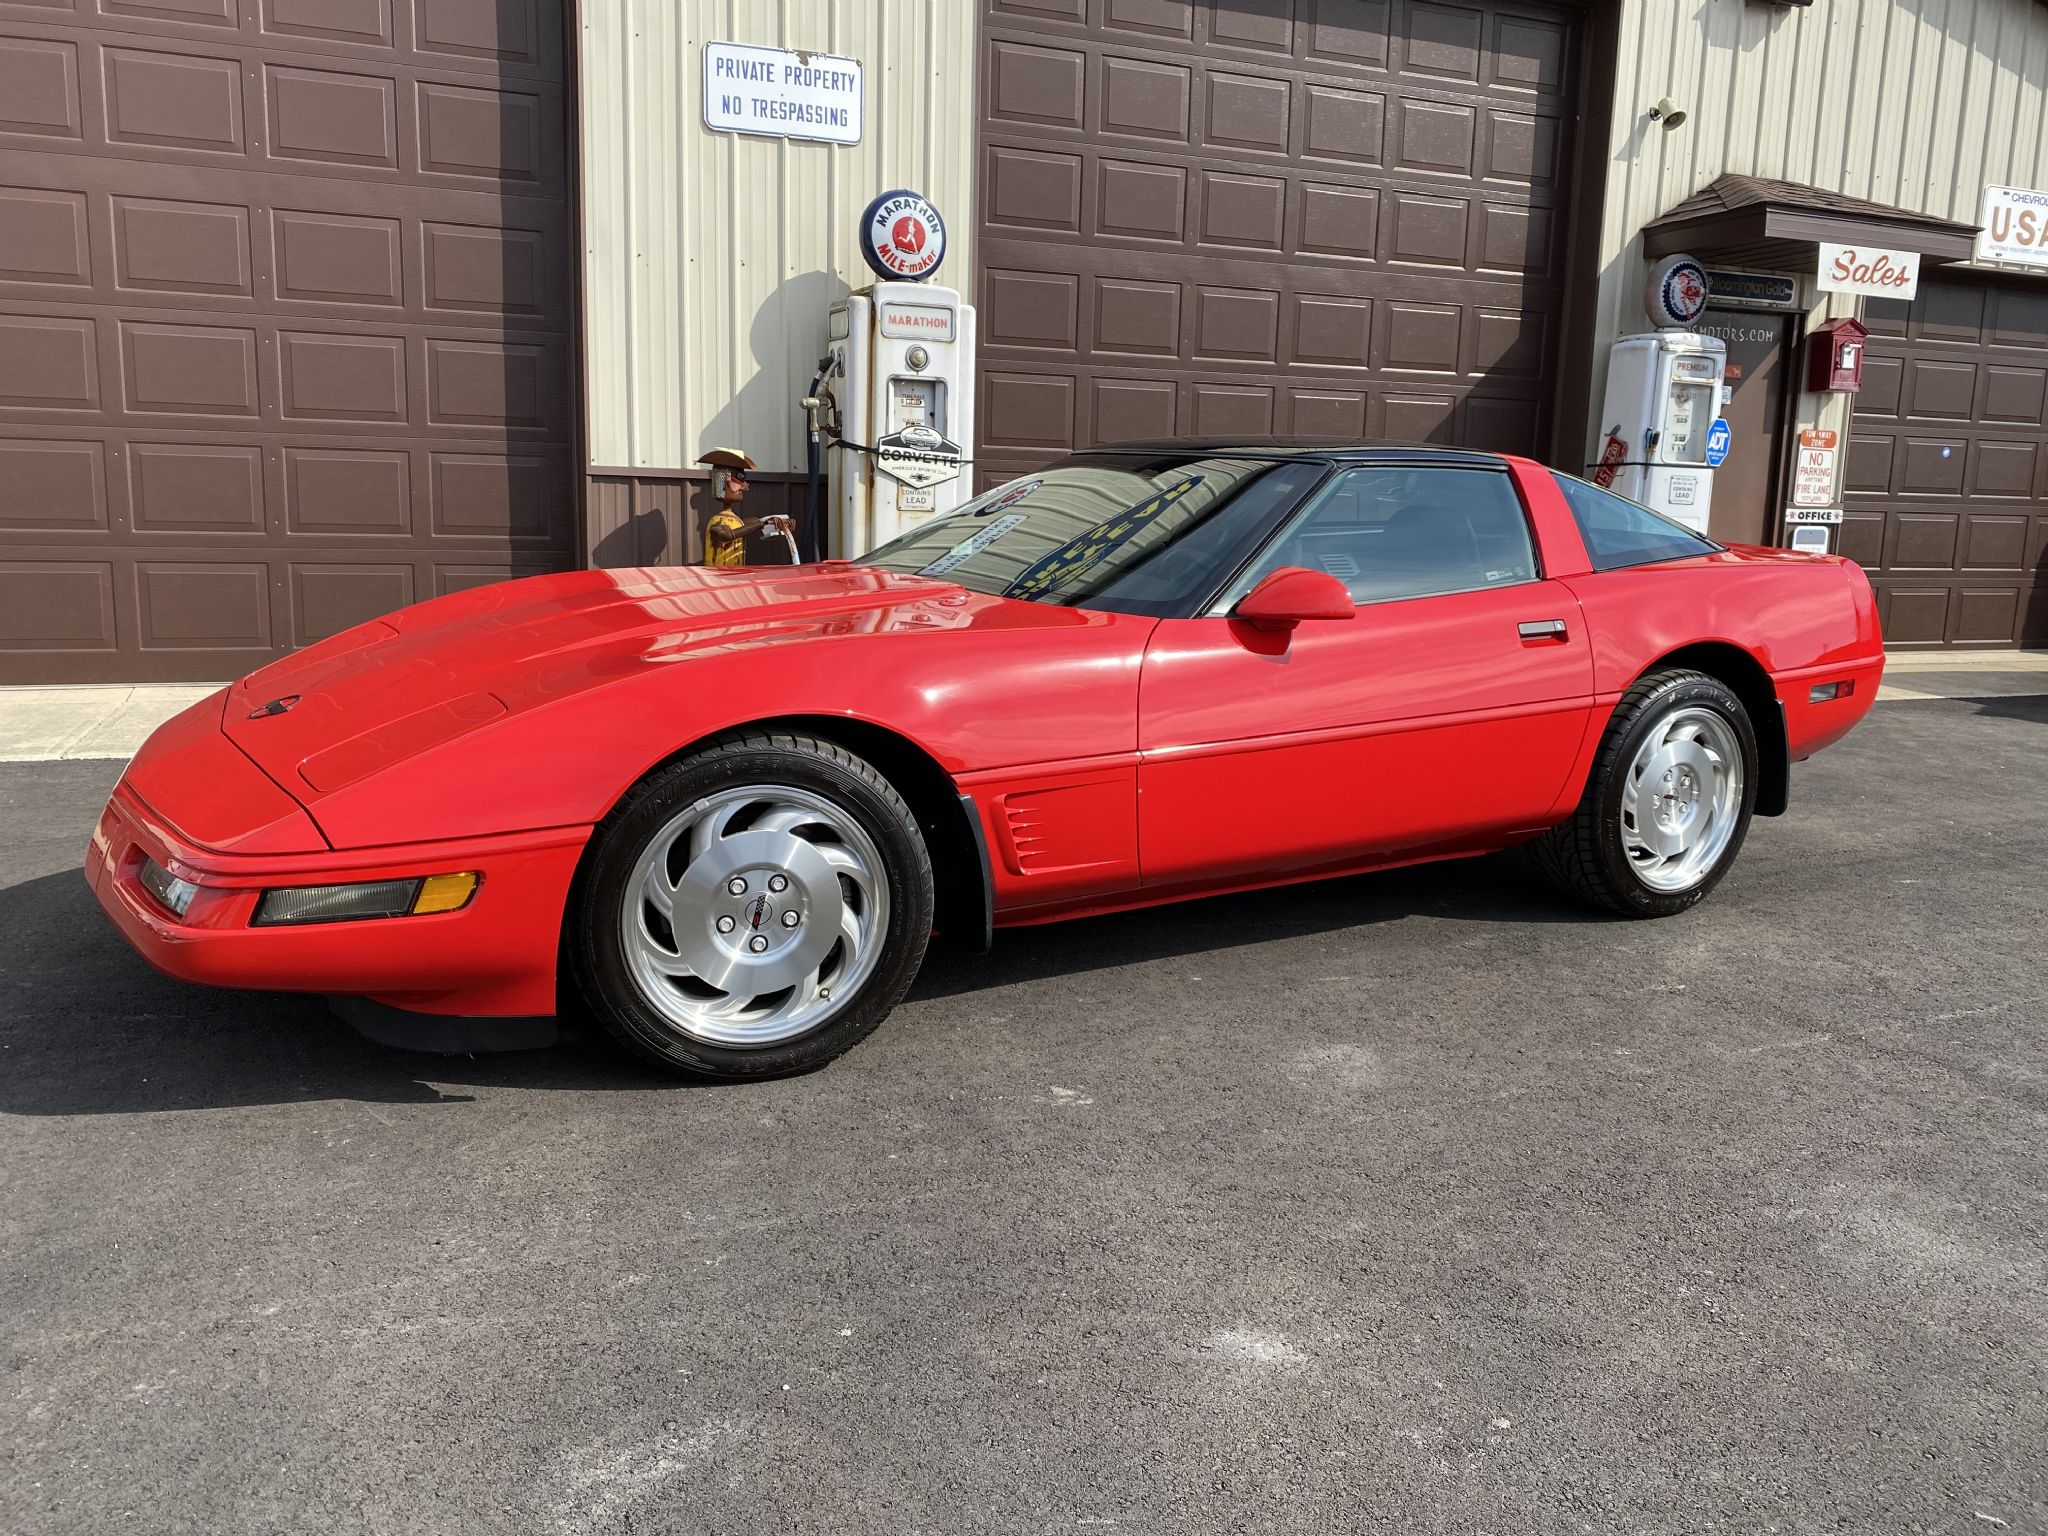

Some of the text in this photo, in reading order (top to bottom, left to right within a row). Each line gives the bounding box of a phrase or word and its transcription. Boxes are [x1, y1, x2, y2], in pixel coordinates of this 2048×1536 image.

[716, 57, 856, 92] PRIVATE PROPERTY
[722, 94, 848, 127] NO TRESPASSING
[876, 198, 940, 234] MARATHON
[877, 242, 937, 273] MILE-maker
[1832, 249, 1911, 287] Sales
[1765, 281, 1786, 296] Gold
[888, 314, 948, 329] MARATHON
[1677, 362, 1709, 373] PREMIUM
[1708, 431, 1729, 451] ADT
[1810, 439, 1826, 448] ZONE
[881, 448, 958, 469] CORVETTE
[1809, 452, 1824, 466] NO
[1800, 466, 1831, 478] PARKING
[901, 489, 932, 497] CONTAINS
[1797, 484, 1831, 495] FIRE LANE
[906, 497, 927, 505] LEAD
[1797, 511, 1832, 521] OFFICE
